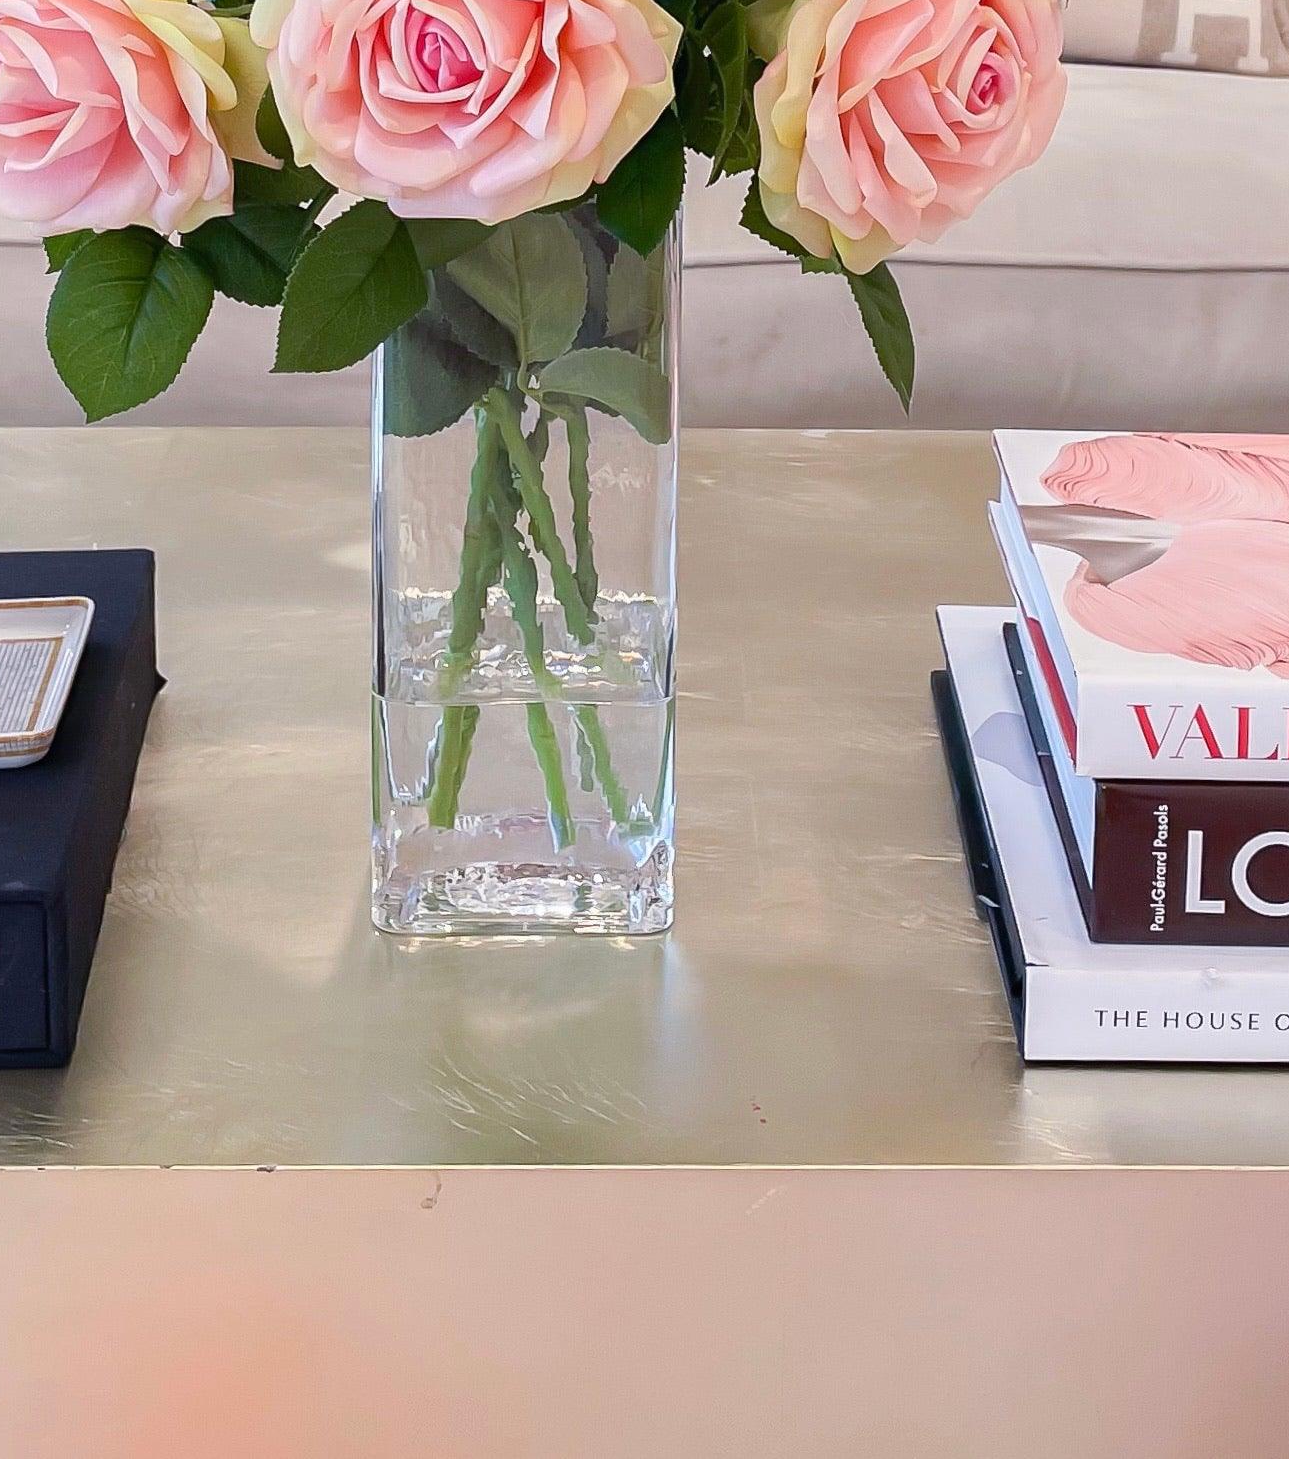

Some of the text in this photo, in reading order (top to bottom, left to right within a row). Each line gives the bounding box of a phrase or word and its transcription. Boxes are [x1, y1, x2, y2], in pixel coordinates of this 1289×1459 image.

[1150, 804, 1169, 931] Paul-Gérard Pasols
[1095, 1009, 1148, 1029] THE
[1163, 1010, 1261, 1031] HOUSE
